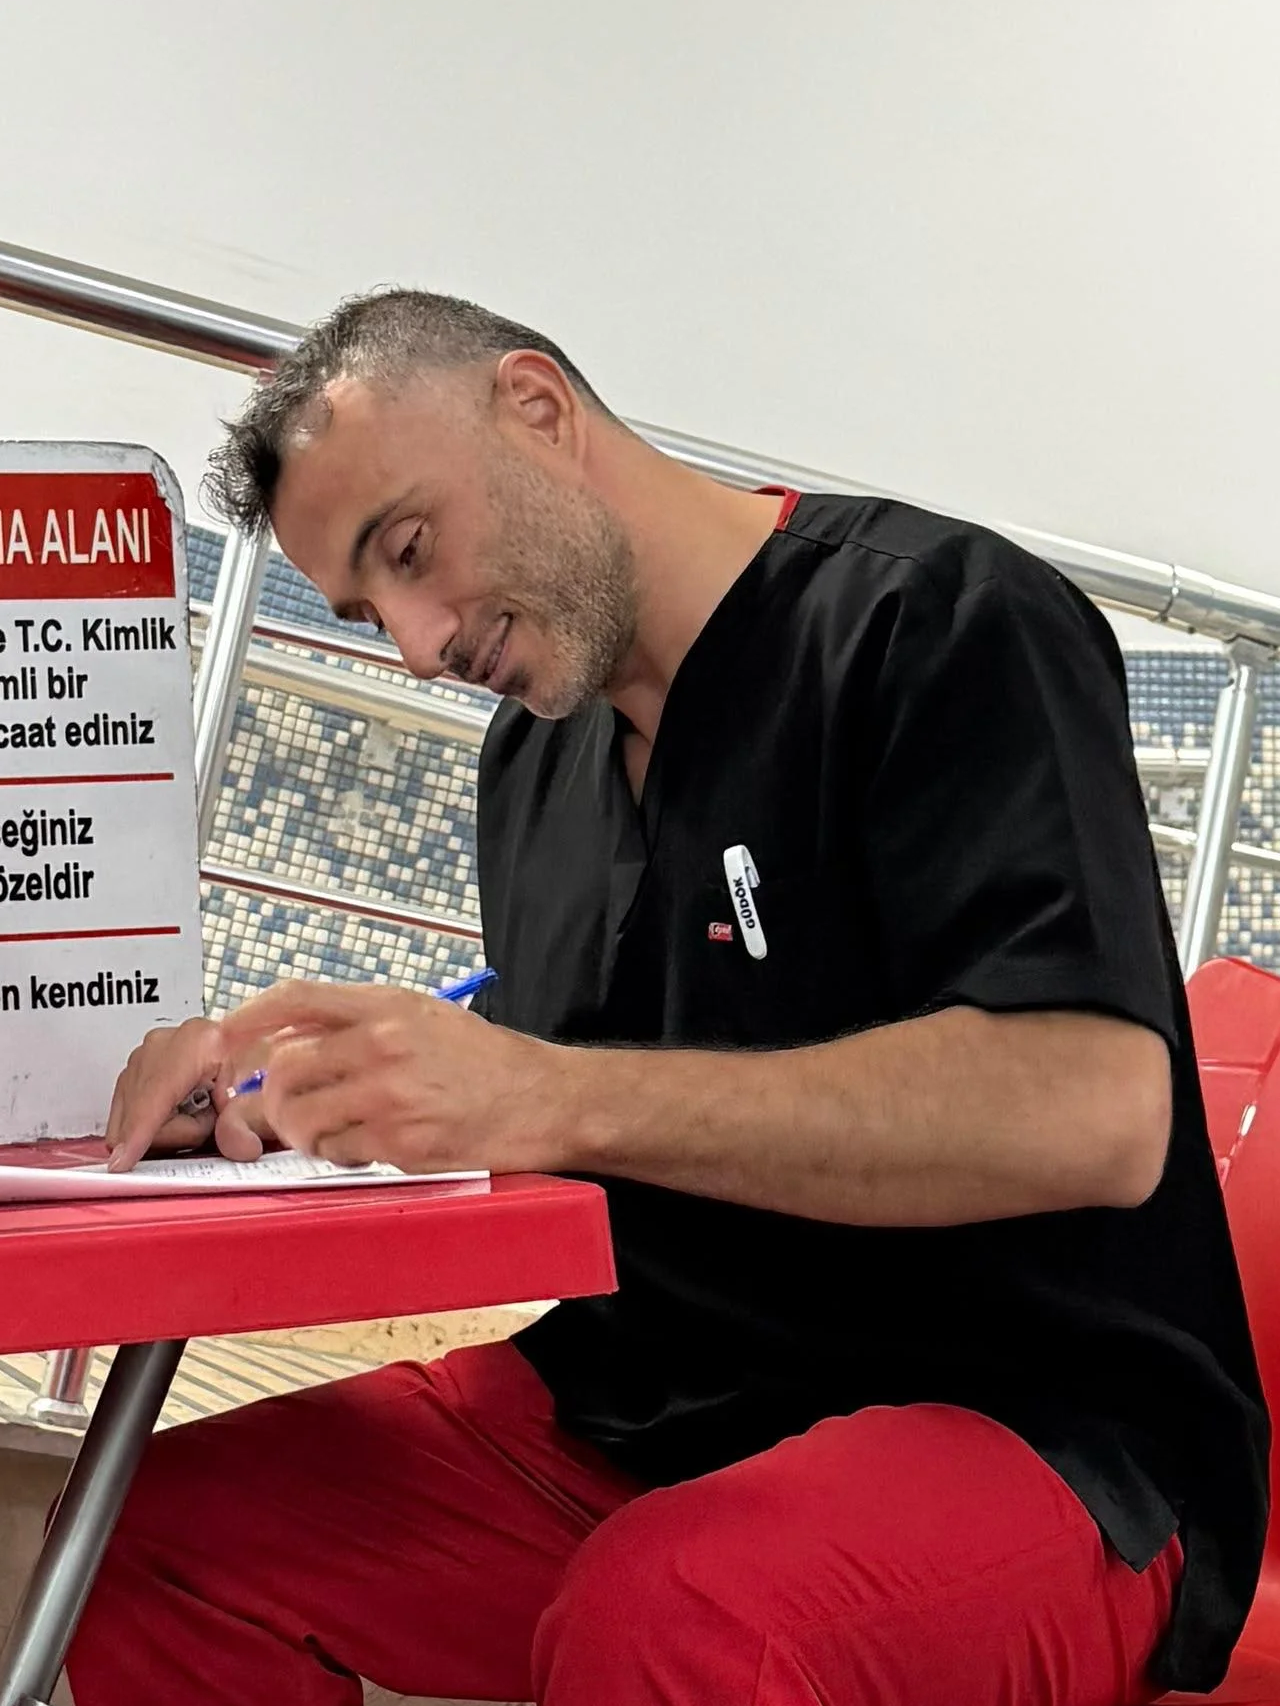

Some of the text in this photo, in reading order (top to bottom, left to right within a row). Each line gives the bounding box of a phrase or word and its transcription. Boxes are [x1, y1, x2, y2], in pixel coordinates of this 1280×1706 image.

[40, 508, 151, 565] ALANI
[14, 618, 72, 653] T.C.
[82, 617, 177, 652] Kimlik
[47, 665, 89, 700] bir
[64, 712, 155, 748] ediniz
[30, 969, 160, 1010] kendiniz
